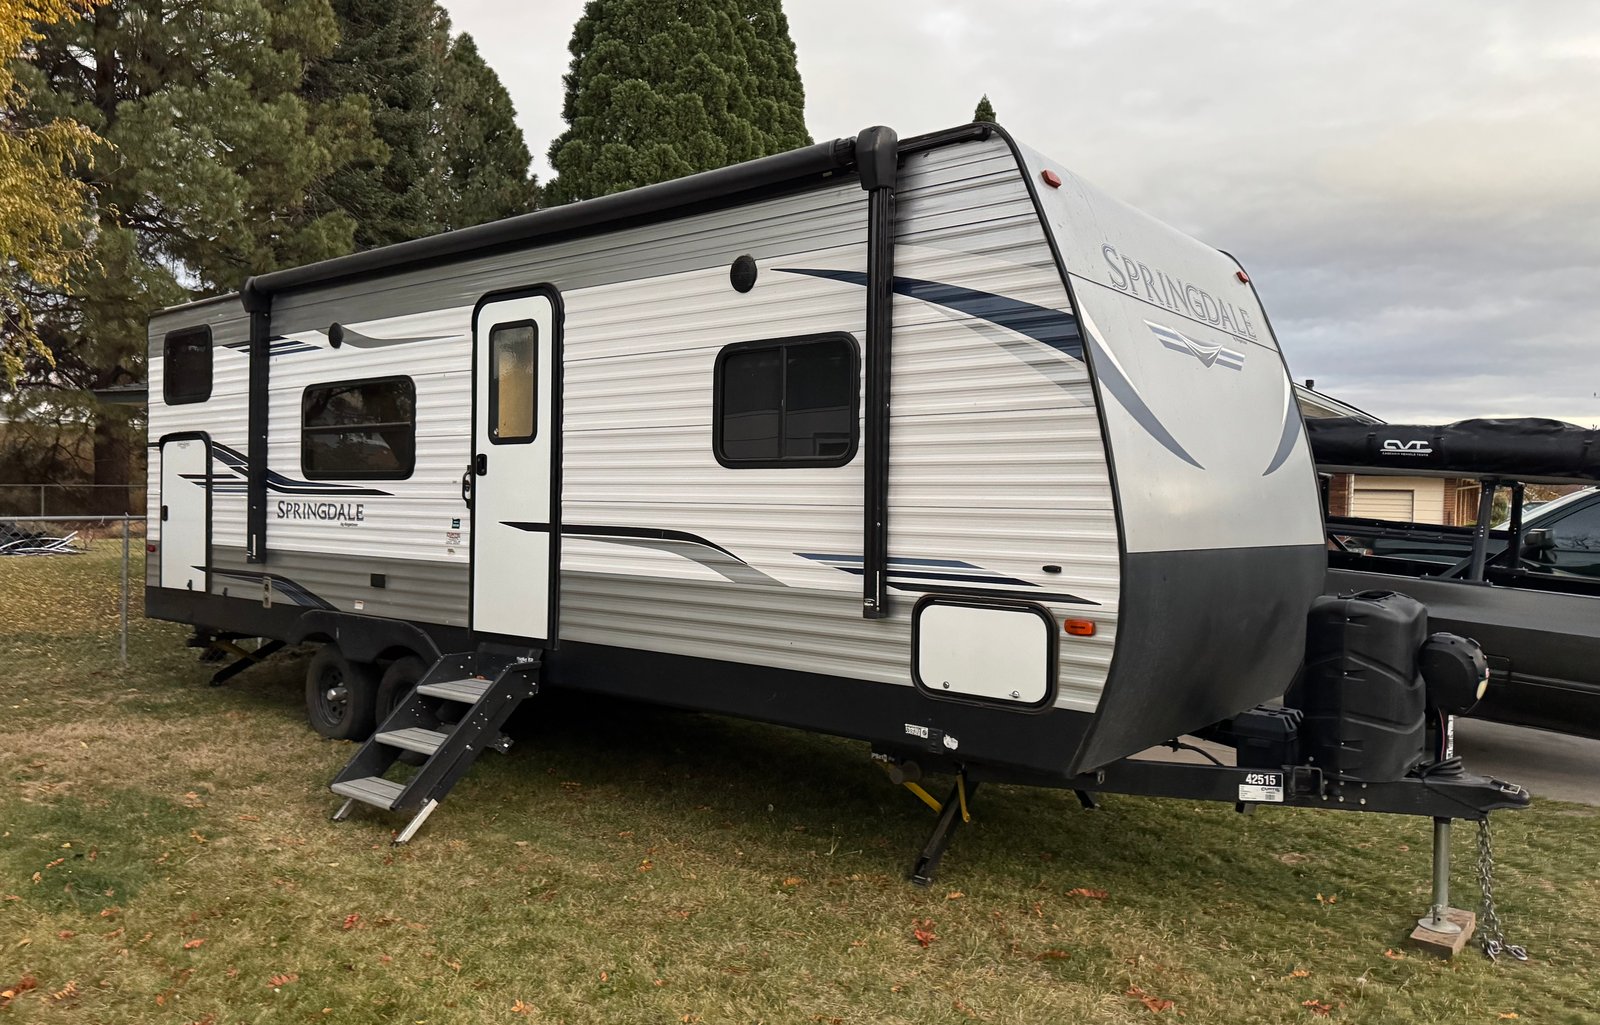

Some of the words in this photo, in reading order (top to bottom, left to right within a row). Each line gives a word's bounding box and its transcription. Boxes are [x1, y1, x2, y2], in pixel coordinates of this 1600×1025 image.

[1101, 242, 1257, 341] SPRINGDALE
[1383, 439, 1429, 450] CVT
[277, 500, 364, 521] SPRINGDALE
[1245, 773, 1276, 785] 42515
